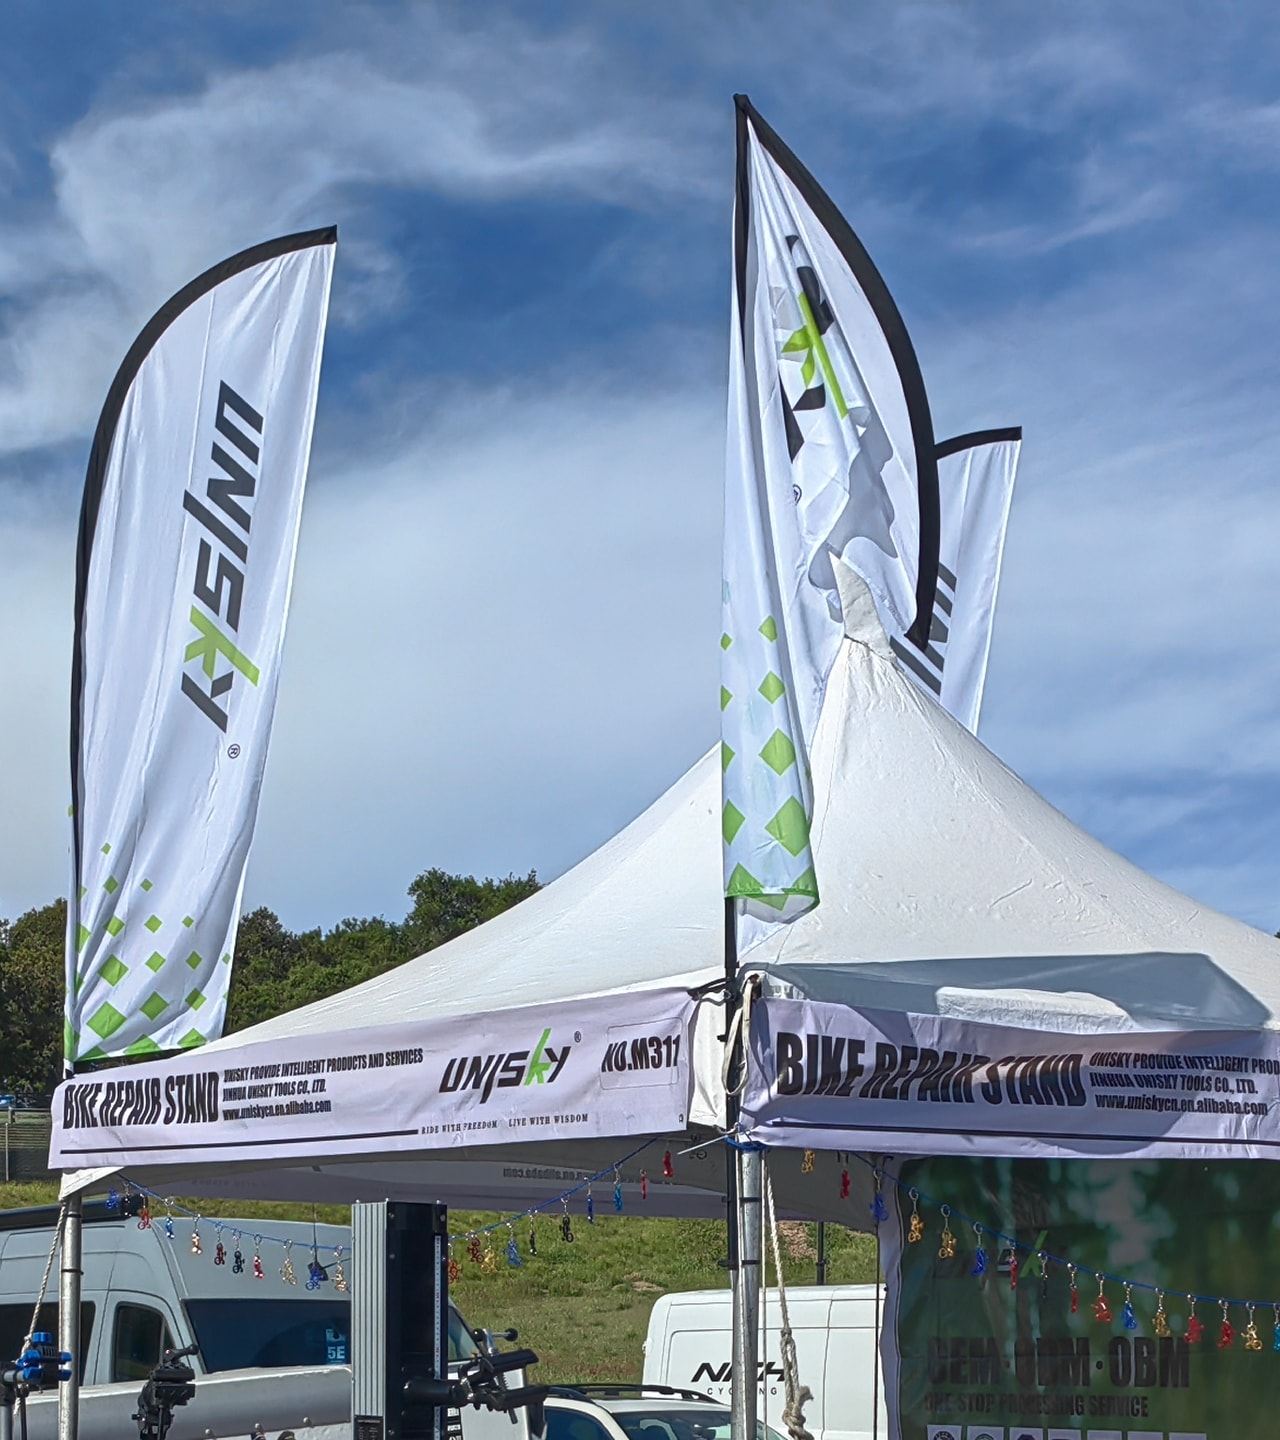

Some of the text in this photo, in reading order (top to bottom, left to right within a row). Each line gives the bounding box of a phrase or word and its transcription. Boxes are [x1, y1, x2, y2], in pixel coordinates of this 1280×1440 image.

[250, 1064, 281, 1080] PROVIDE
[281, 1059, 326, 1077] INTELLIGENT
[327, 1054, 368, 1073] PRODUCTS
[368, 1053, 385, 1068] AND
[385, 1048, 424, 1067] SERVICES
[601, 1034, 681, 1073] NO.M311
[1089, 1051, 1132, 1068] UNISKY
[1132, 1053, 1183, 1071] PROVIDE
[1183, 1055, 1251, 1073] INTELLIGENT
[776, 1031, 1087, 1107] BIKE REPAIR STAND
[274, 1081, 297, 1097] TOOLS
[312, 1079, 327, 1094] LTD.
[1090, 1072, 1259, 1095] JINHUA UNISKY TOOLS CO., LTD.
[63, 1071, 219, 1129] BIKE REPAIR STAND
[1095, 1094, 1269, 1117] www.uniskycn.en.alibaba.com
[422, 1113, 589, 1135] RIDE WITH FREEDOM LIVE WITH WISDOM
